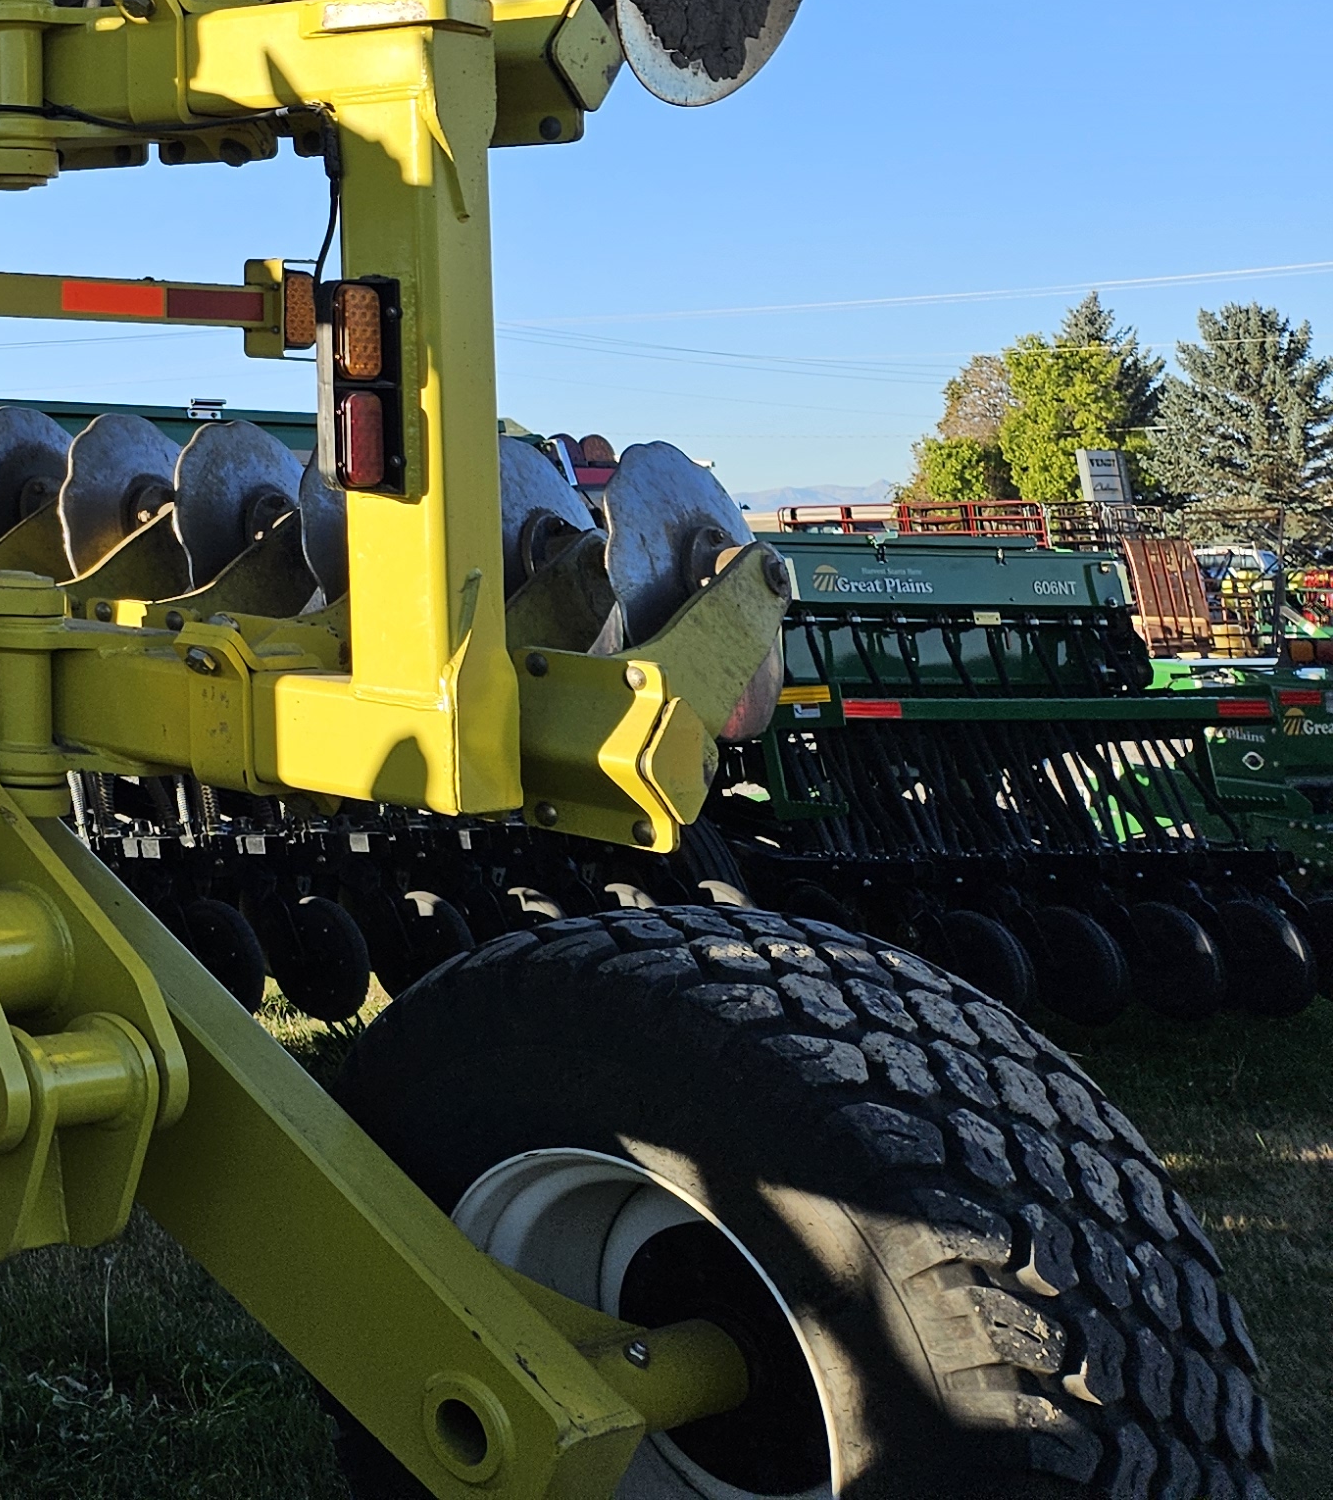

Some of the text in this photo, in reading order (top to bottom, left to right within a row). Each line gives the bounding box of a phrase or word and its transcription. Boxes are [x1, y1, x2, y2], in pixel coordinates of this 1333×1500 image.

[837, 576, 934, 594] Great Plains
[1033, 580, 1077, 596] 606NT
